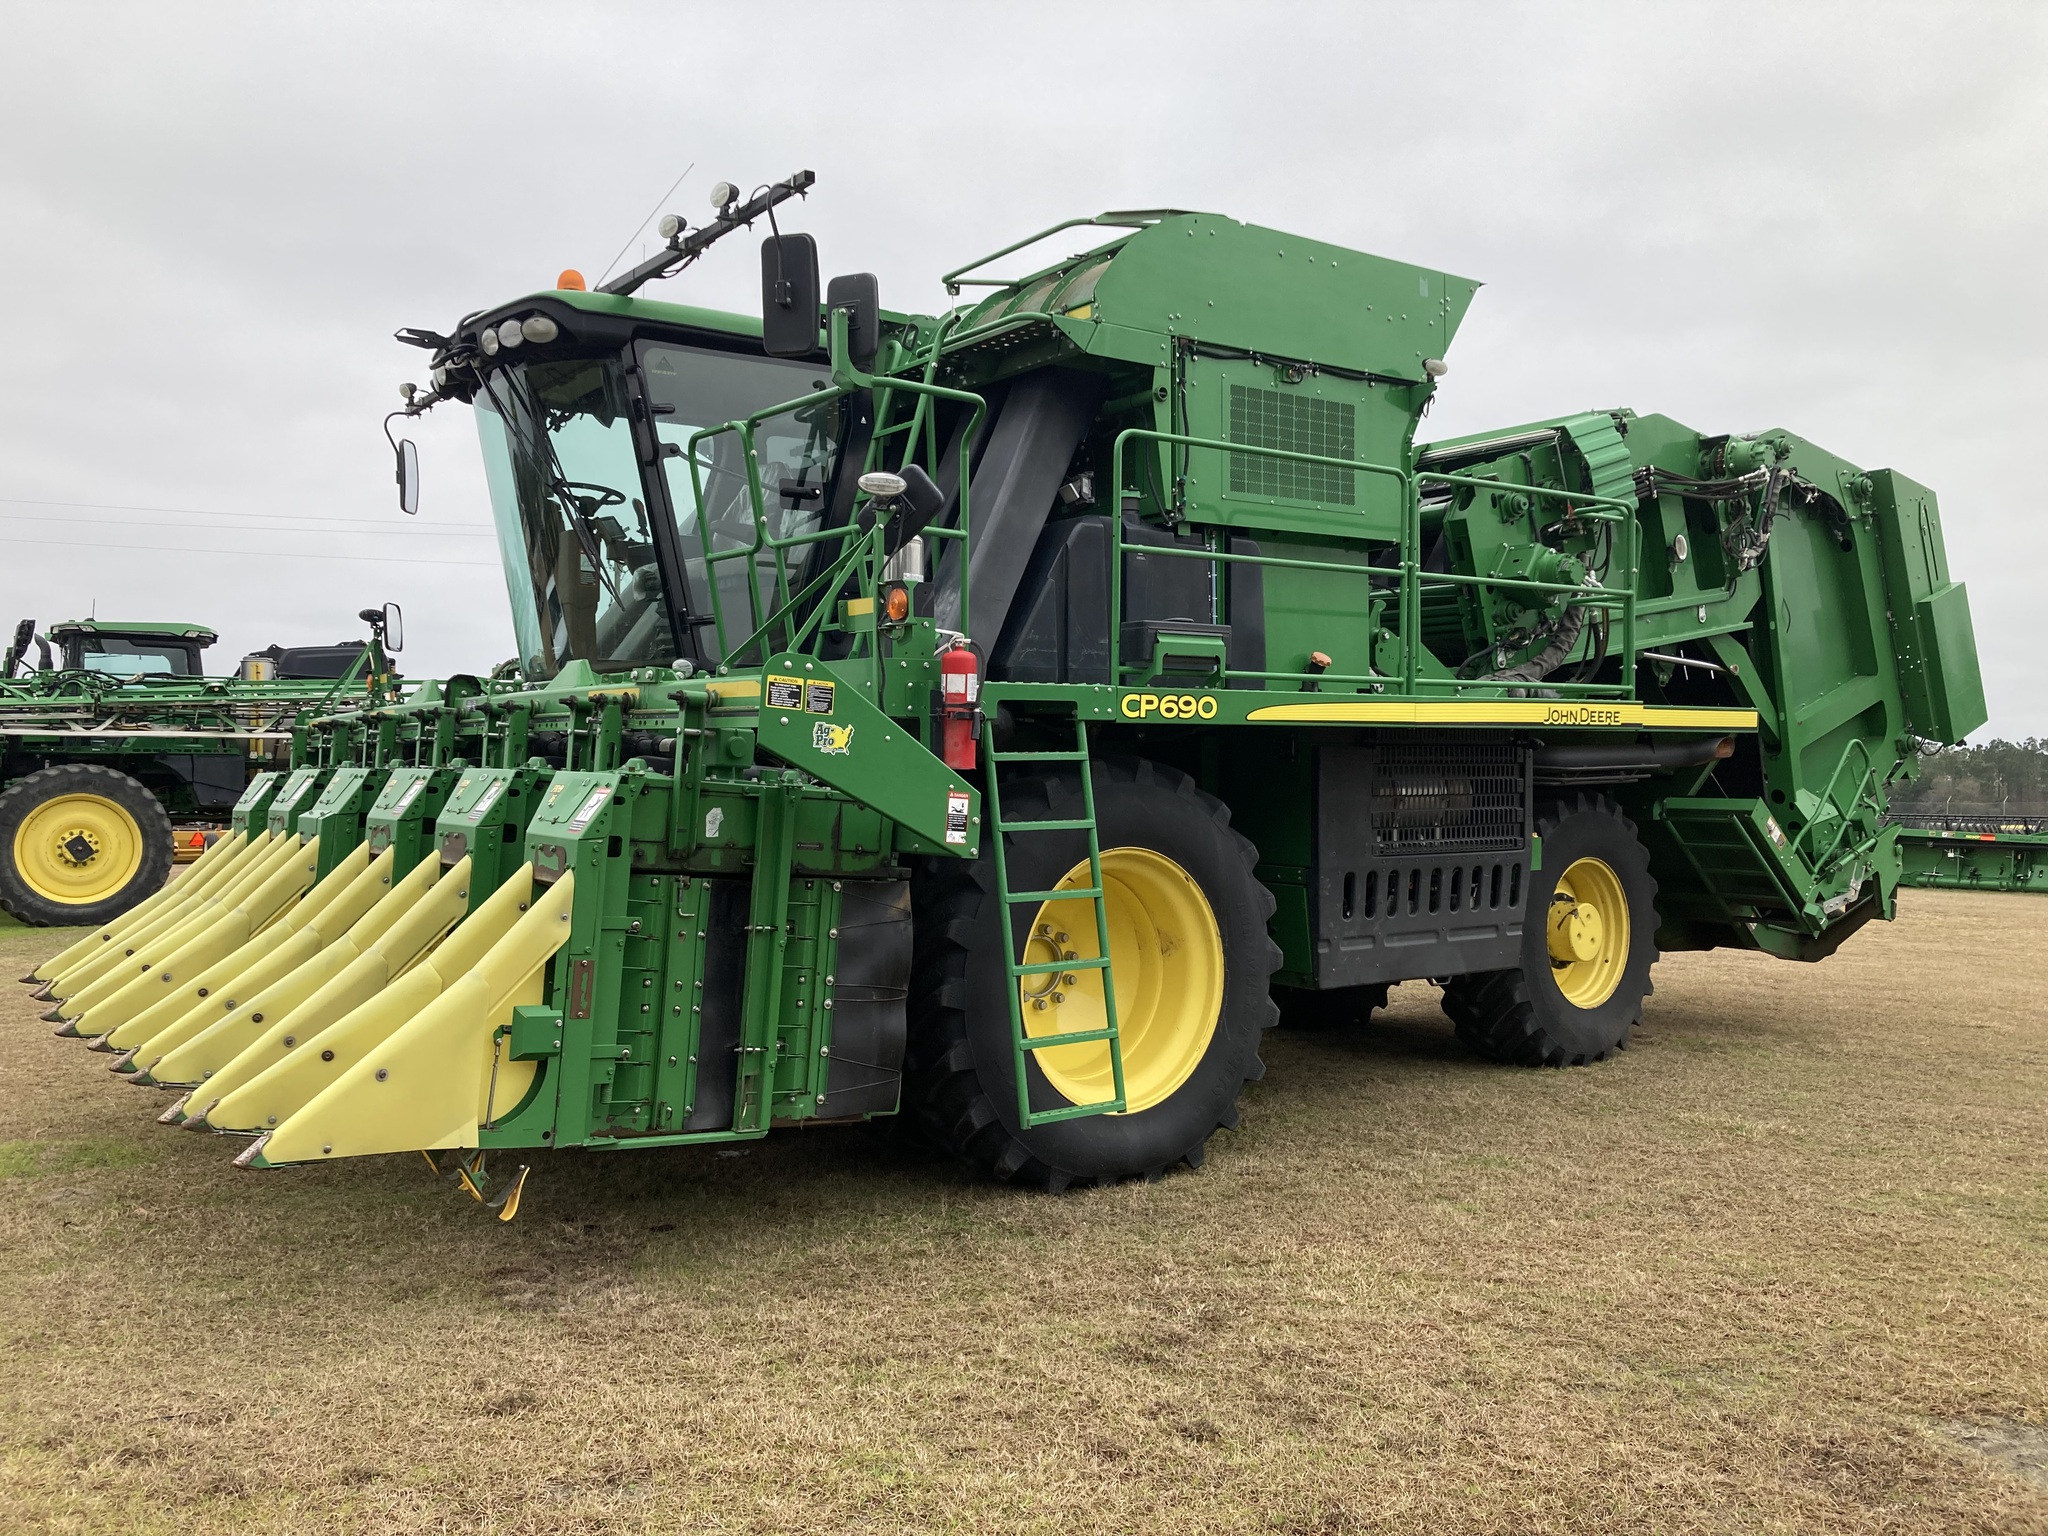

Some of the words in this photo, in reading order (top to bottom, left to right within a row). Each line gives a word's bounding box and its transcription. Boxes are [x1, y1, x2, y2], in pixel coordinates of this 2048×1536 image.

[1121, 693, 1218, 720] CP690
[1544, 707, 1578, 723] JOHN
[1580, 708, 1621, 724] DEERE
[816, 723, 835, 737] Ag-
[815, 735, 835, 746] Pro
